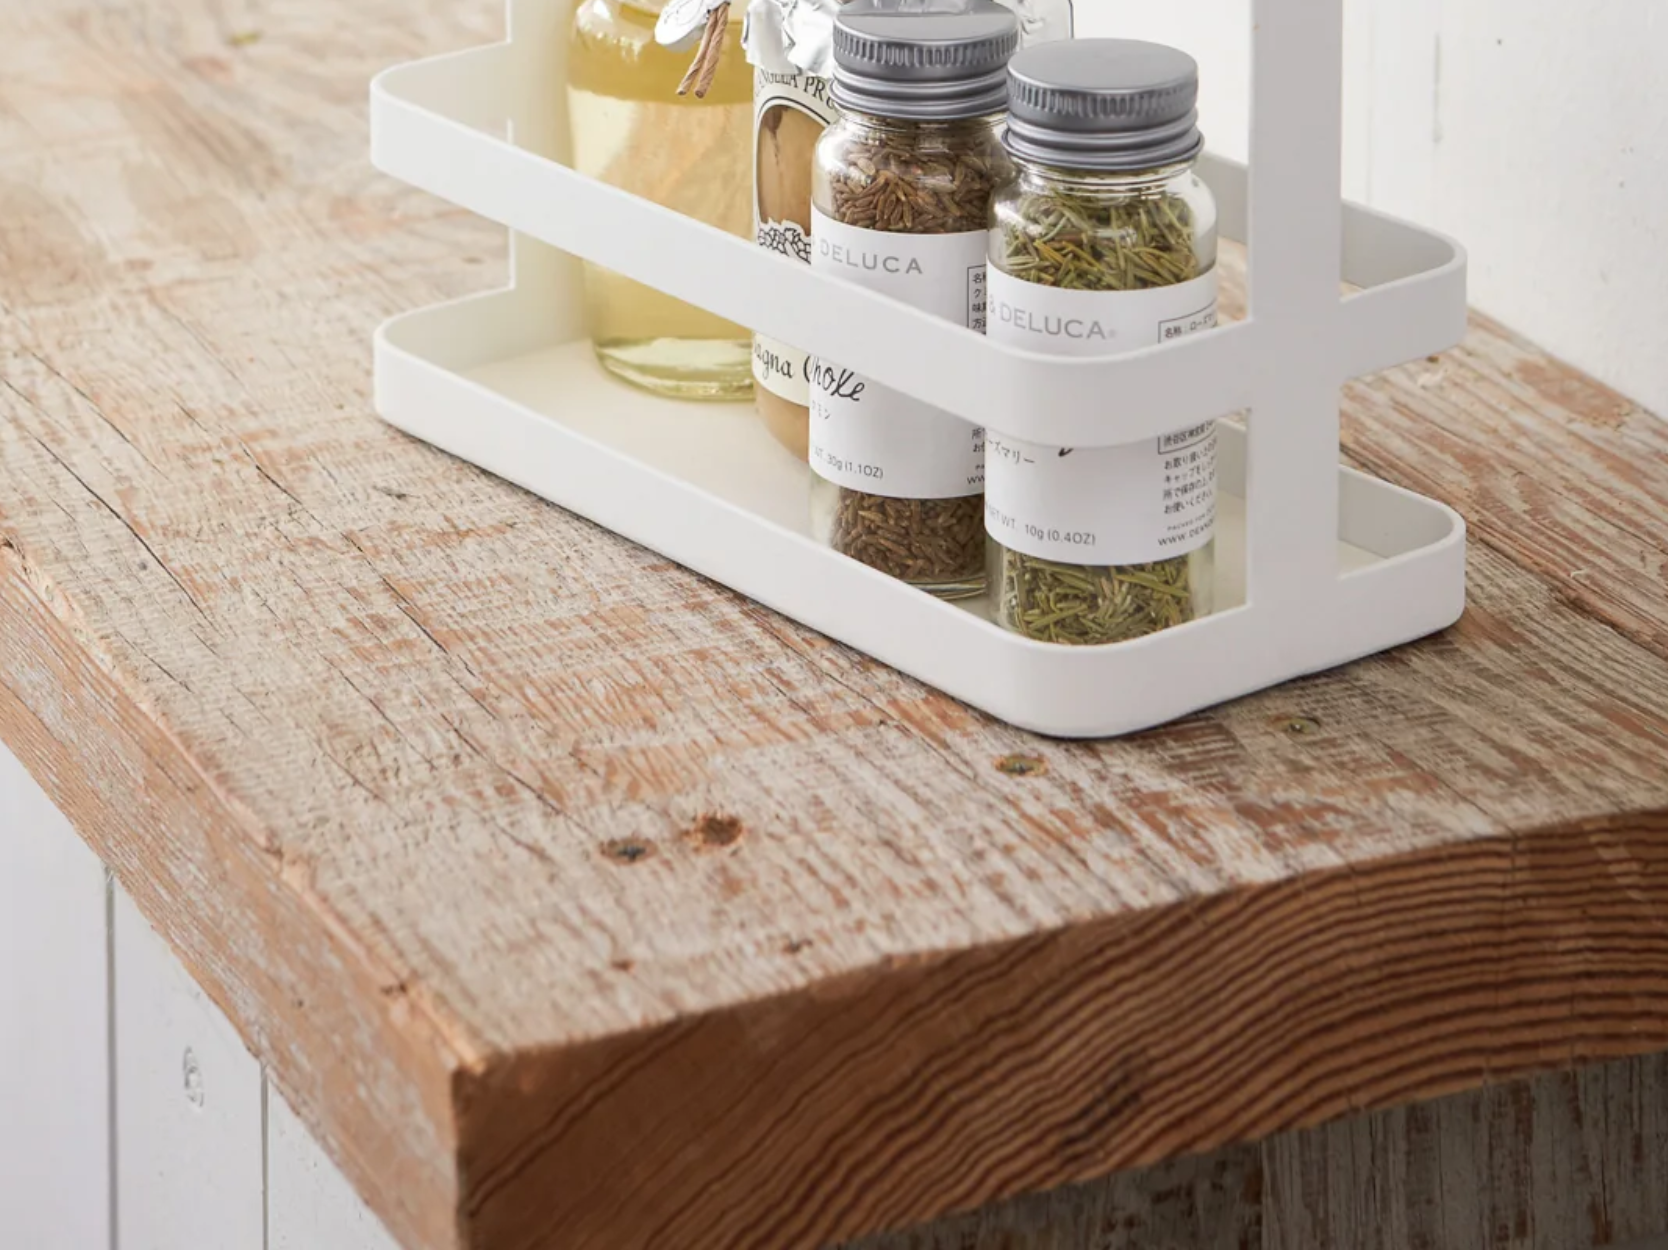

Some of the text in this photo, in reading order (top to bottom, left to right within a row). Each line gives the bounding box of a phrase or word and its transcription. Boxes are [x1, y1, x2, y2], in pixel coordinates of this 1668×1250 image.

[819, 237, 924, 275] DELUCA
[1000, 300, 1107, 340] DELUCA
[1025, 523, 1044, 541] 10g
